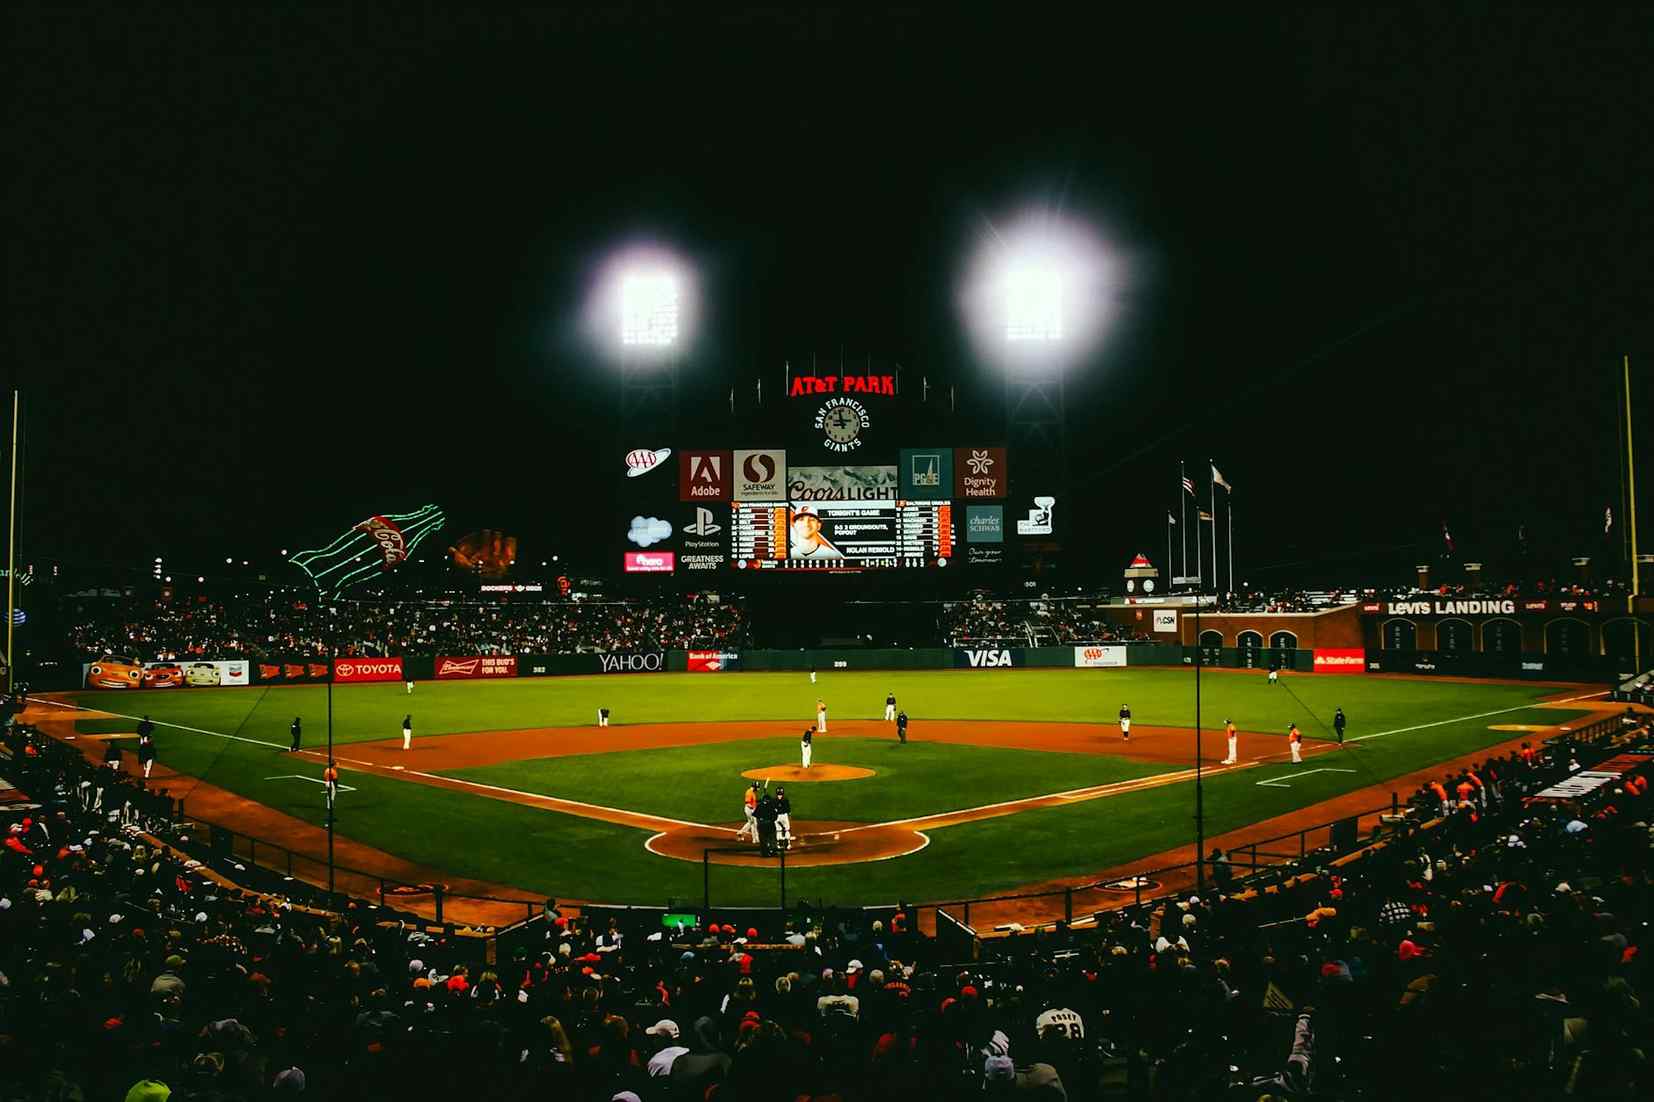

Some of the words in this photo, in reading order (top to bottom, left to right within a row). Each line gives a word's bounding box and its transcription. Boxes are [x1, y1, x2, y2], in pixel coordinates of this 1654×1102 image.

[790, 376, 838, 397] AT&T
[842, 376, 894, 398] PARK
[815, 408, 827, 429] SAN
[825, 397, 870, 428] FRANCISCO
[824, 437, 862, 452] GIANTS
[743, 483, 776, 491] SAFEWAY
[964, 477, 996, 488] Dignity
[691, 486, 720, 496] Adobe
[789, 481, 848, 500] Coors
[848, 487, 898, 500] LIGHT
[966, 488, 996, 497] Health
[681, 555, 724, 563] GREATNESS
[688, 562, 717, 570] AWAITS
[1435, 600, 1515, 615] LANDING
[712, 652, 738, 660] America
[964, 650, 1012, 667] VISA
[599, 653, 664, 672] YAHOO!
[356, 664, 401, 674] TOYOTA
